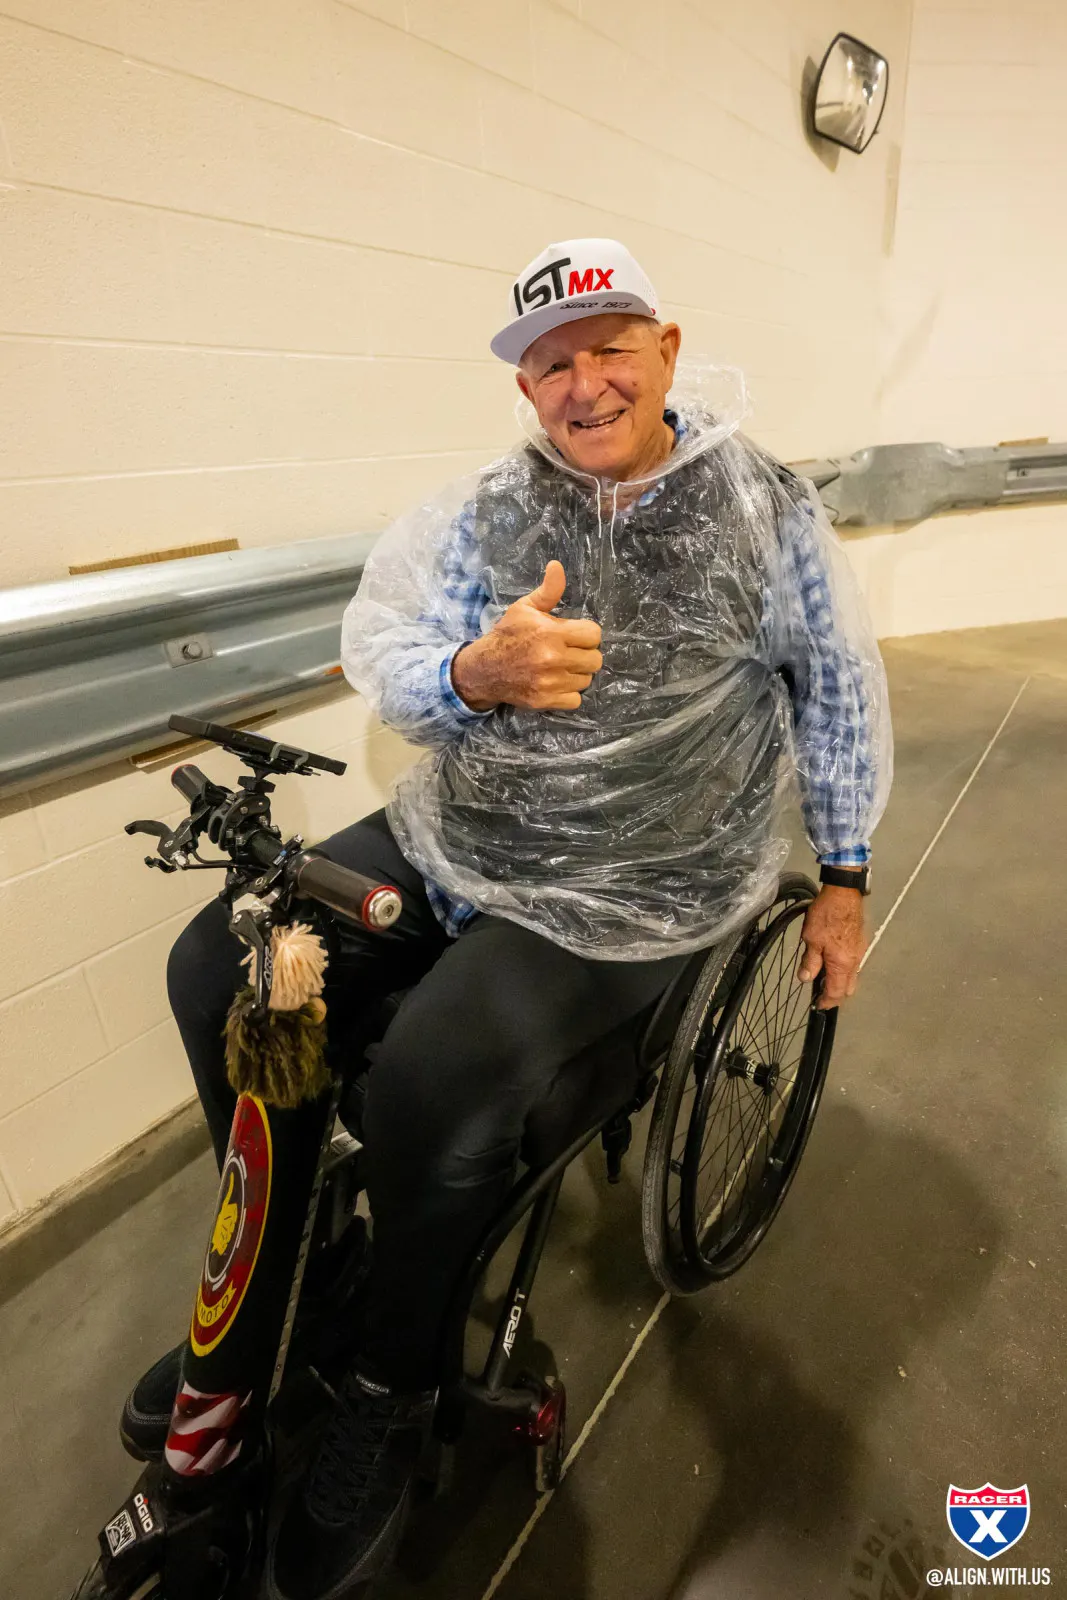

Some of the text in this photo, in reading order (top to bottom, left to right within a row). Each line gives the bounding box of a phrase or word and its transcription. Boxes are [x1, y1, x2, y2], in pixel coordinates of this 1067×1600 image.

[568, 268, 614, 296] MX
[503, 1287, 525, 1358] AERO T
[133, 1493, 154, 1533] OGIO
